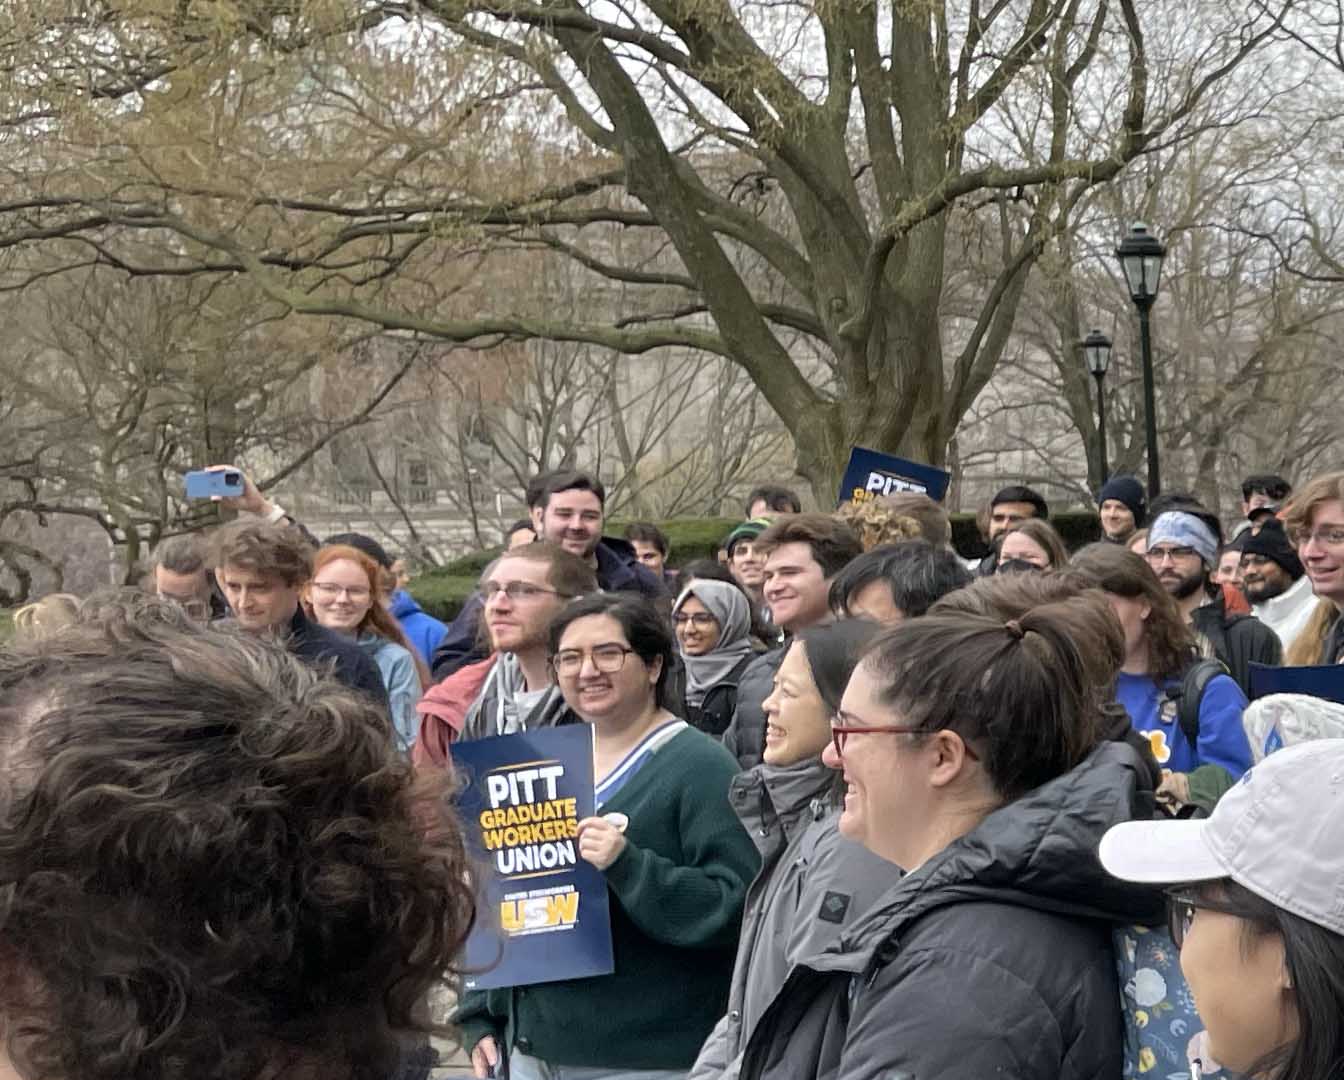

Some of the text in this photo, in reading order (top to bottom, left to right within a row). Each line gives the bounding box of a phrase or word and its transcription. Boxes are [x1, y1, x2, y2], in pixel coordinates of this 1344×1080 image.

[487, 765, 564, 807] PITT
[479, 797, 577, 829] GRADUATE
[483, 818, 578, 851] WORKERS
[496, 840, 576, 874] UNION
[500, 891, 580, 930] USW
